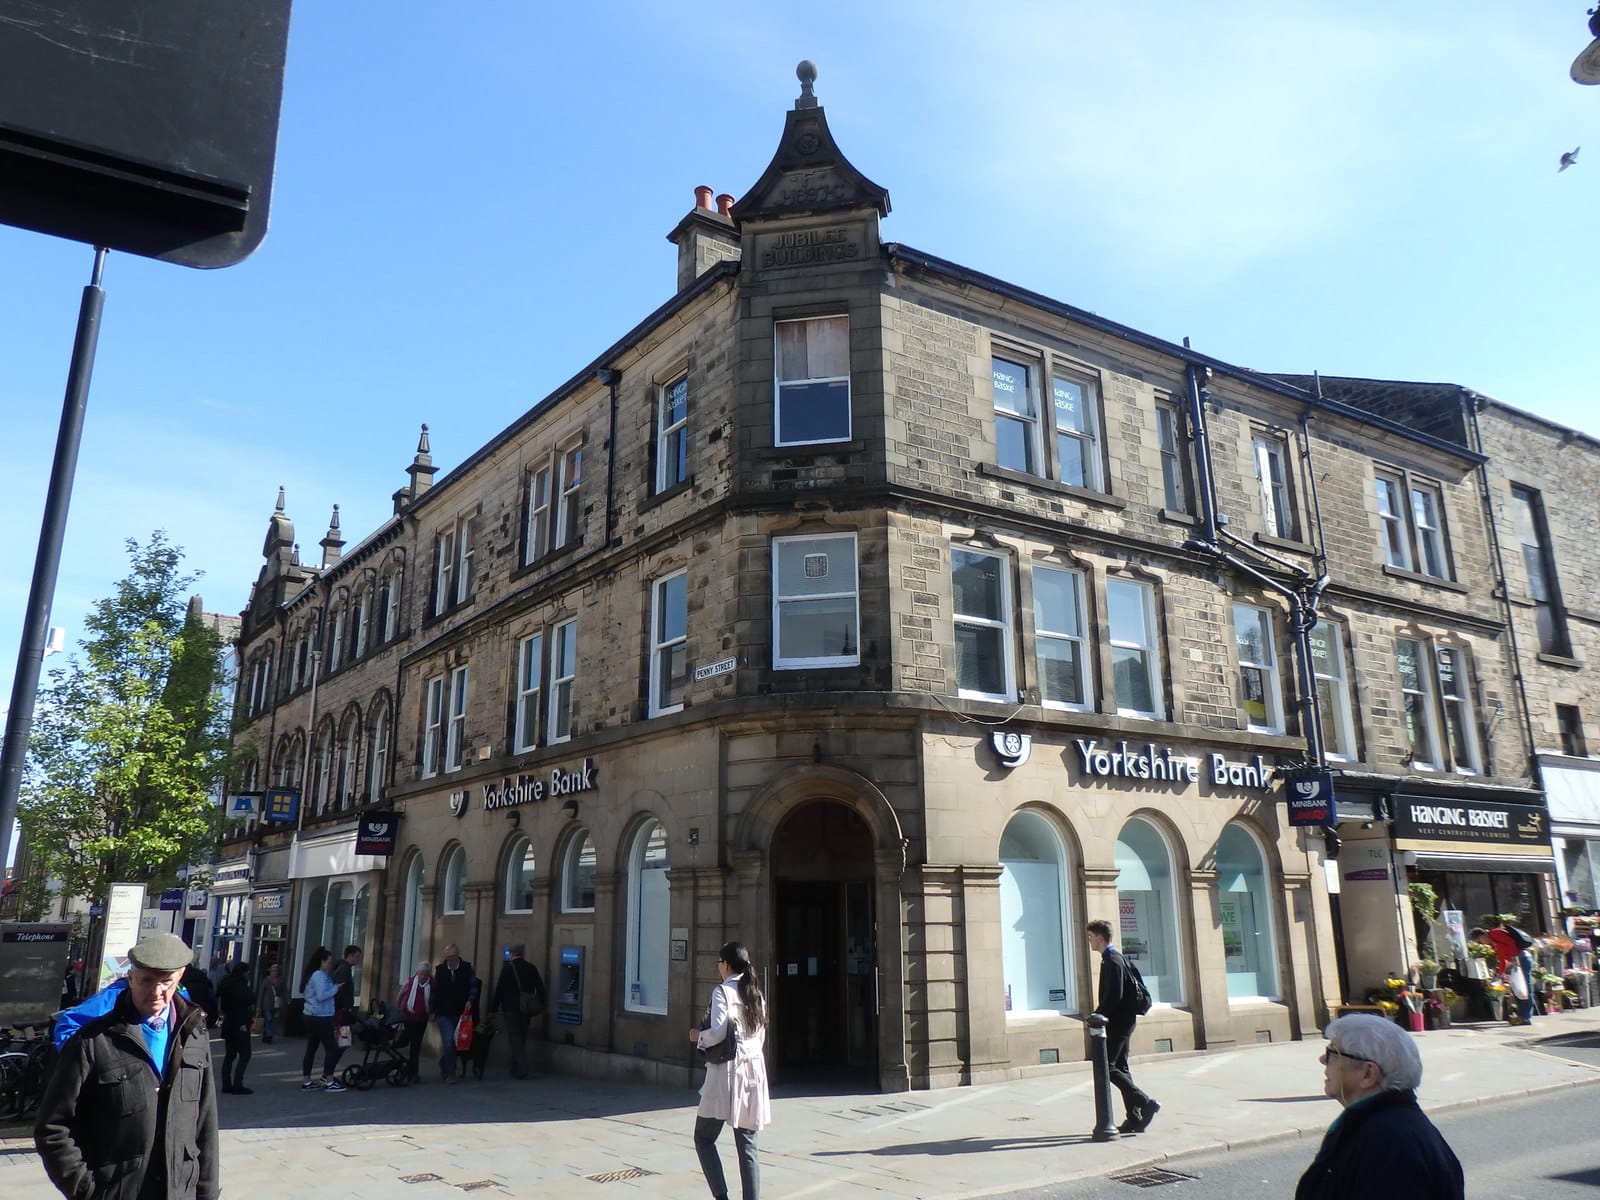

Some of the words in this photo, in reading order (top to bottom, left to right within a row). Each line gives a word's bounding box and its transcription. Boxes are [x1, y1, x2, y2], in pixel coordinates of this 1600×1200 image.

[774, 228, 848, 249] JUBILEE
[763, 243, 859, 267] BUILDINGS
[697, 666, 714, 678] PENNY
[714, 660, 734, 672] STREET
[1076, 739, 1200, 783] Yorkshire
[1209, 753, 1274, 790] Bank
[482, 775, 545, 810] Yorkshire
[551, 757, 596, 797] Bank
[1291, 800, 1328, 808] MINIBANK
[1439, 828, 1480, 837] GENERATION
[16, 933, 55, 942] Telephone
